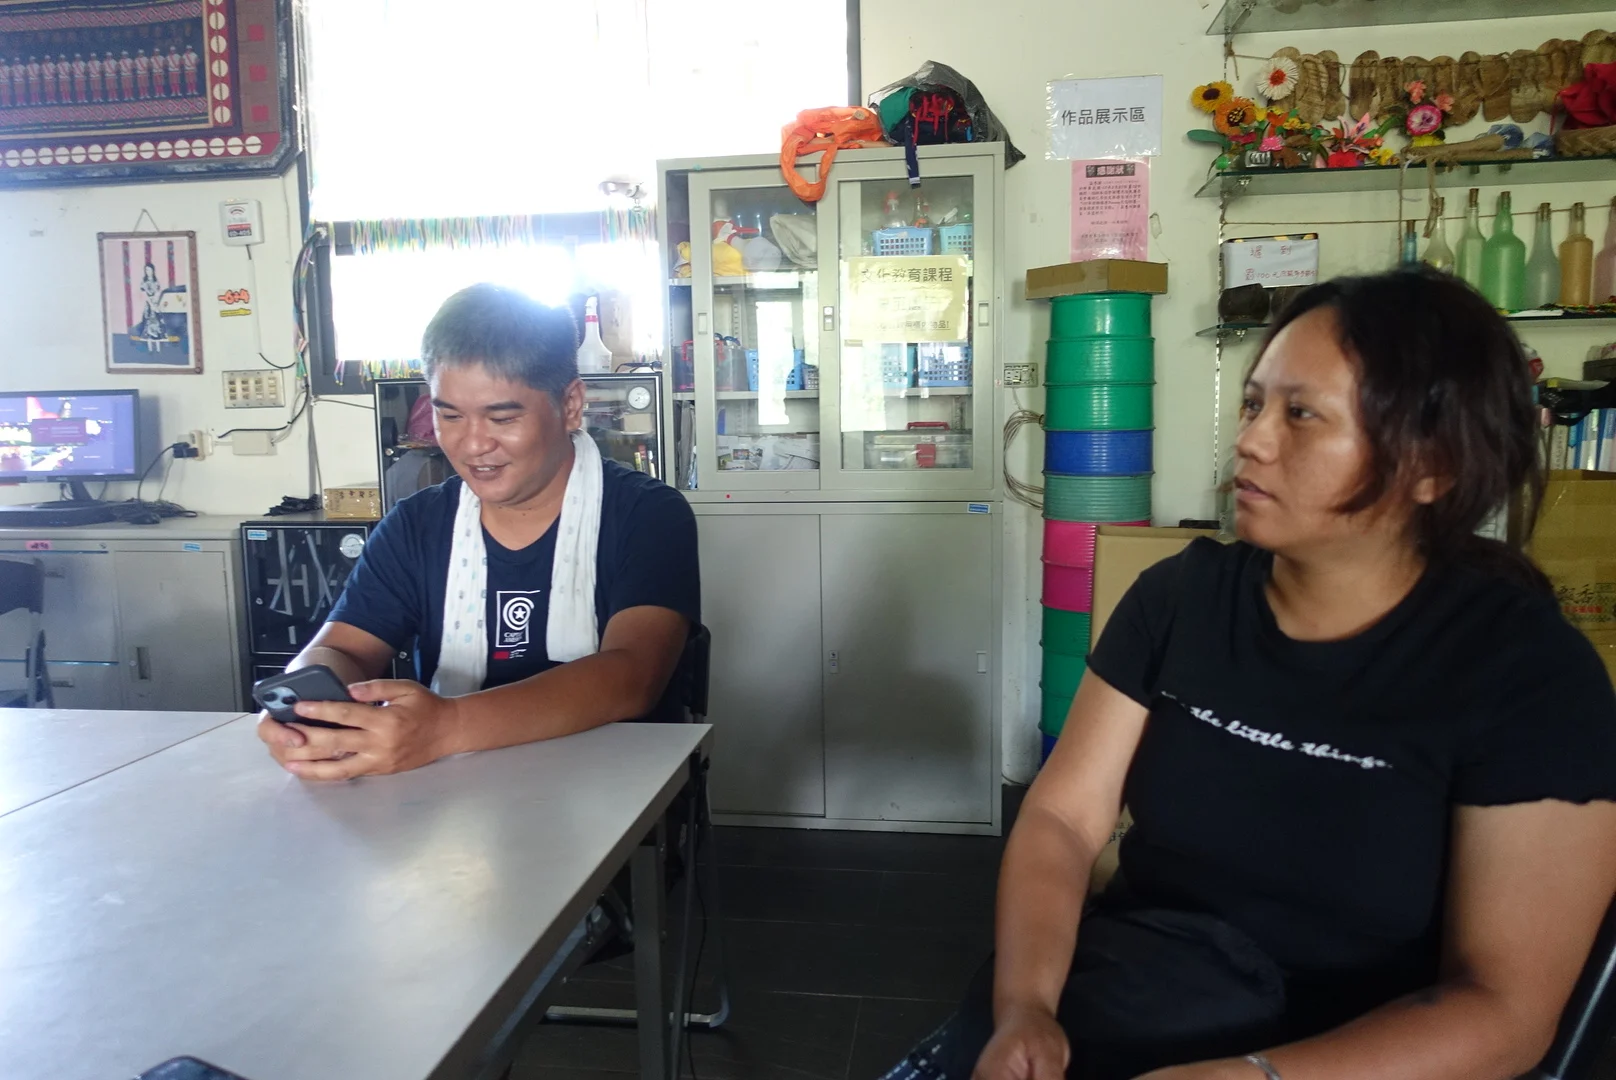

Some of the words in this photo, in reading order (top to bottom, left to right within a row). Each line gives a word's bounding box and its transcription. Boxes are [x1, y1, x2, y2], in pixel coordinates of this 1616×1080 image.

[1061, 106, 1146, 126] 作品展示區
[1190, 706, 1222, 728] the
[1225, 720, 1295, 751] little
